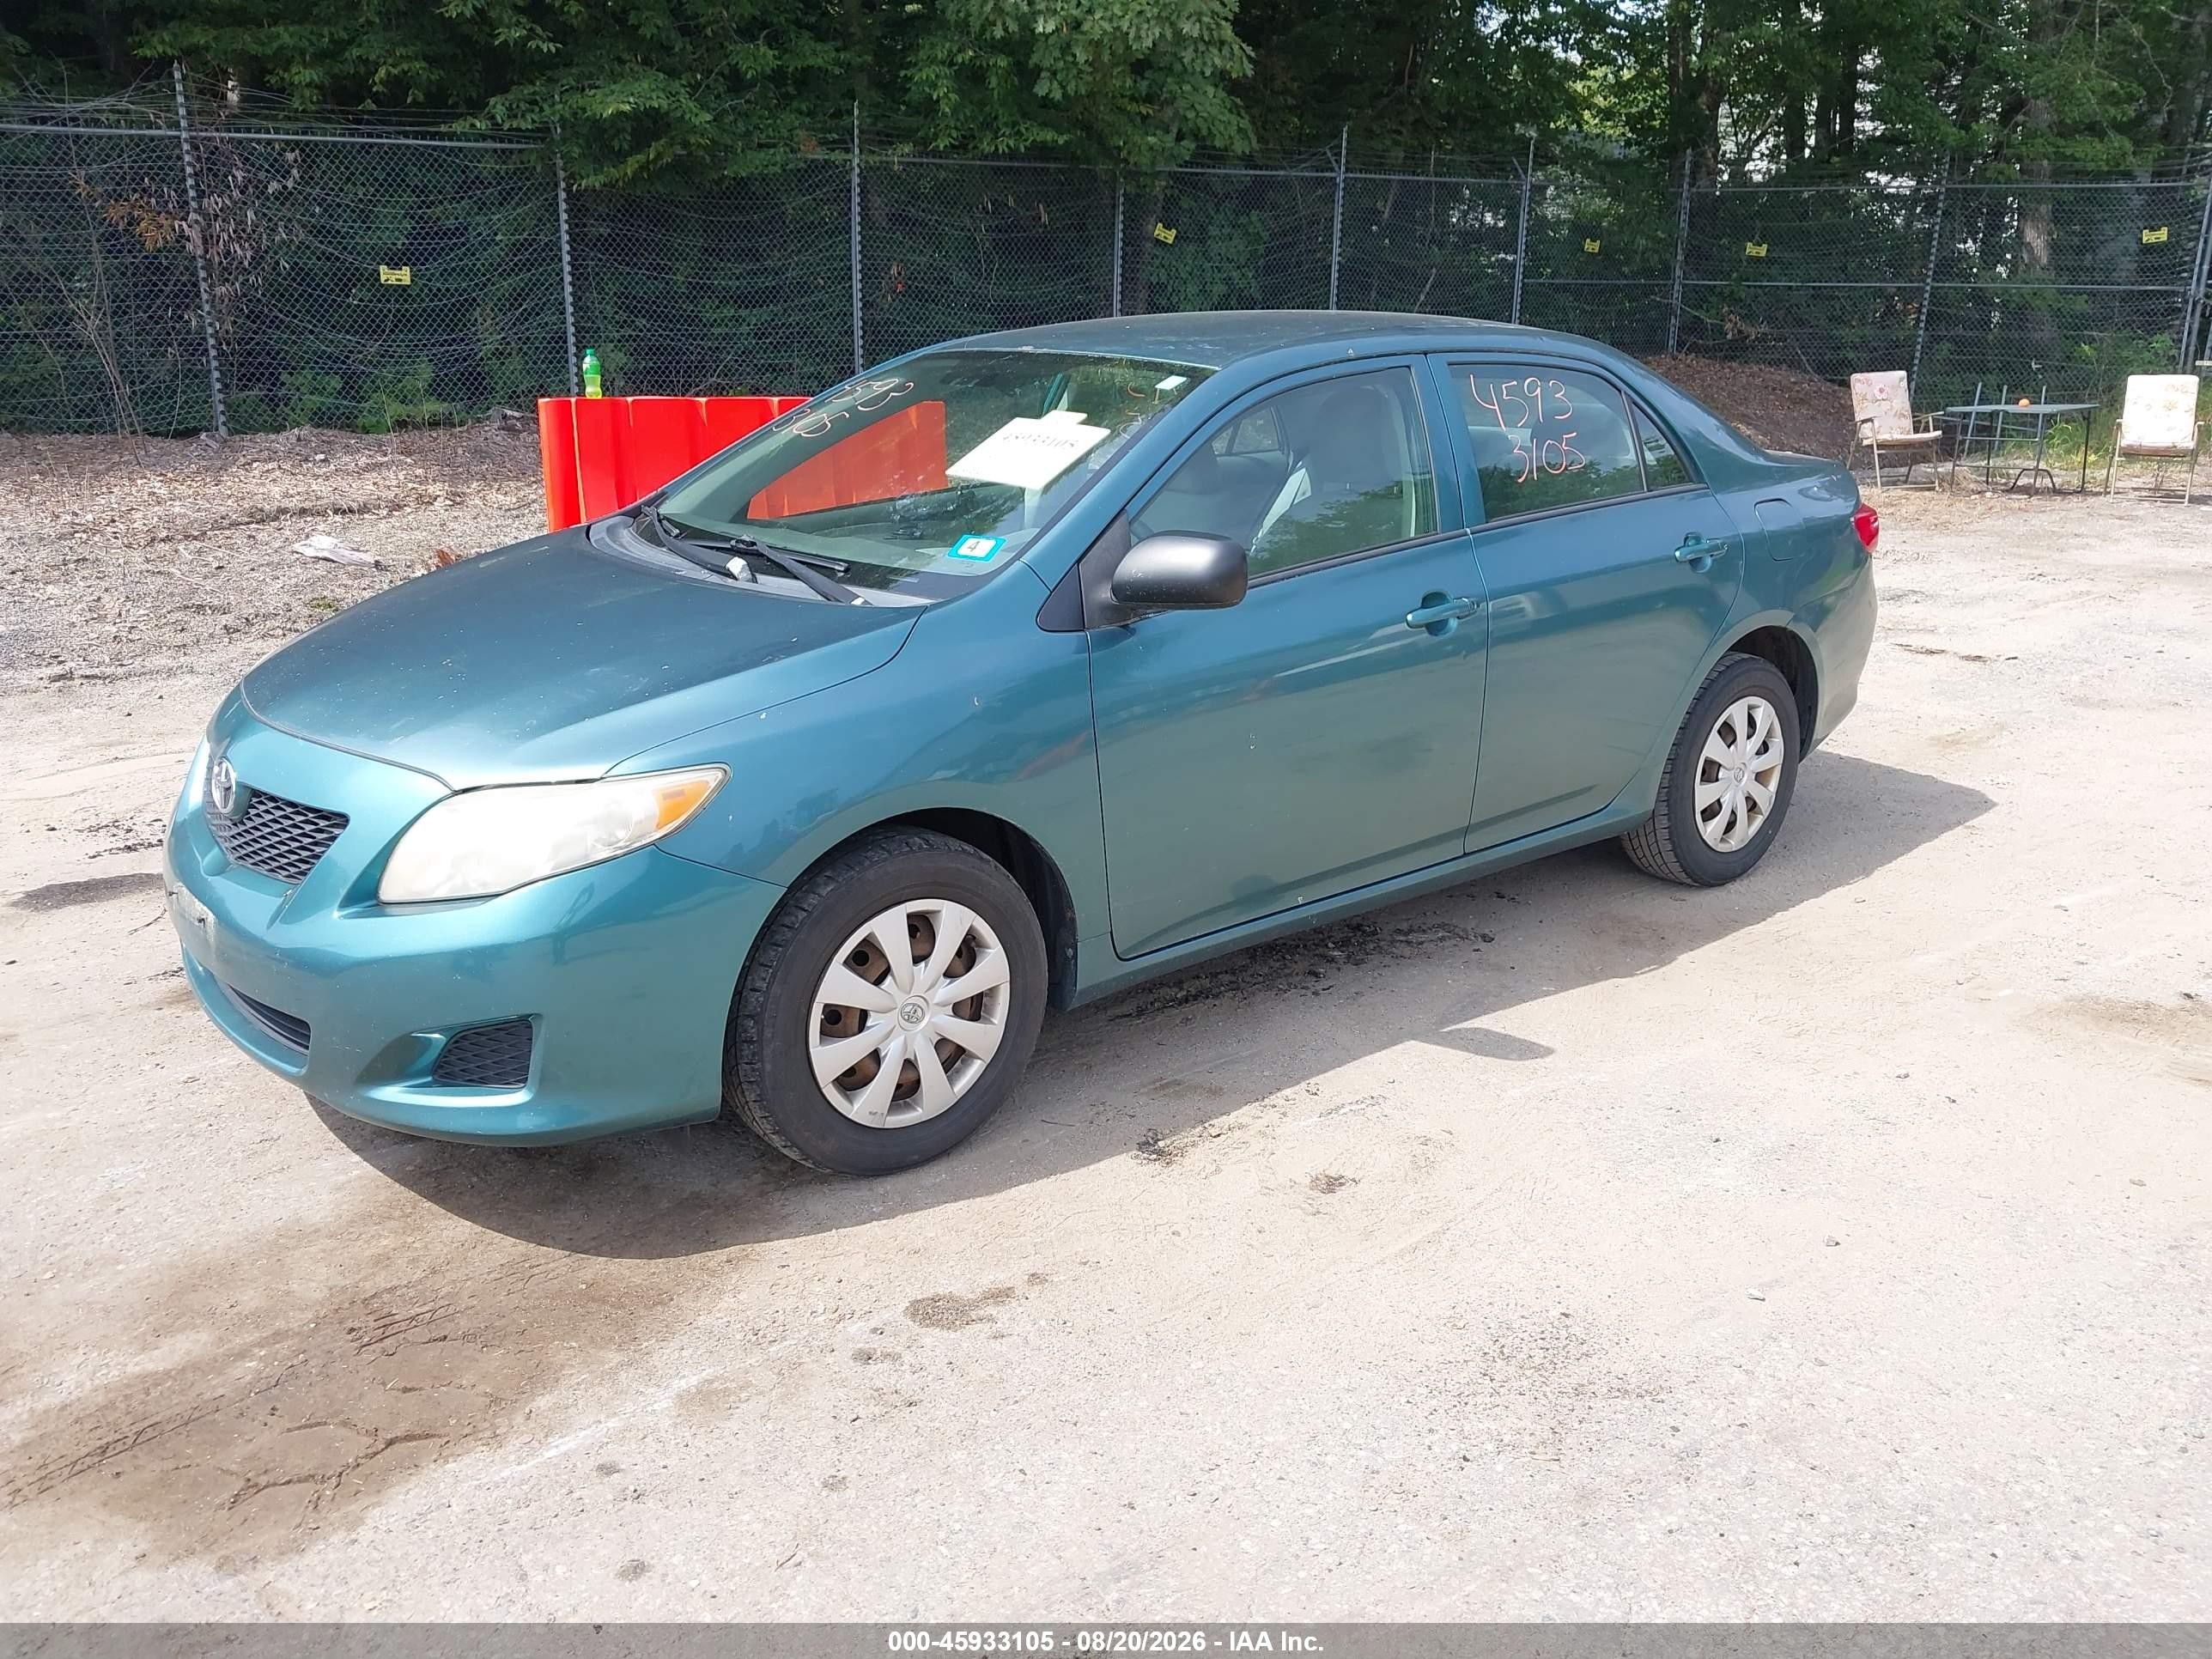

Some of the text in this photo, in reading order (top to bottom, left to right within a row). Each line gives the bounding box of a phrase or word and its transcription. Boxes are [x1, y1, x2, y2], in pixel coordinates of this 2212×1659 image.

[1469, 374, 1574, 432] 4593
[1507, 431, 1587, 483] 3105
[966, 540, 981, 552] 4
